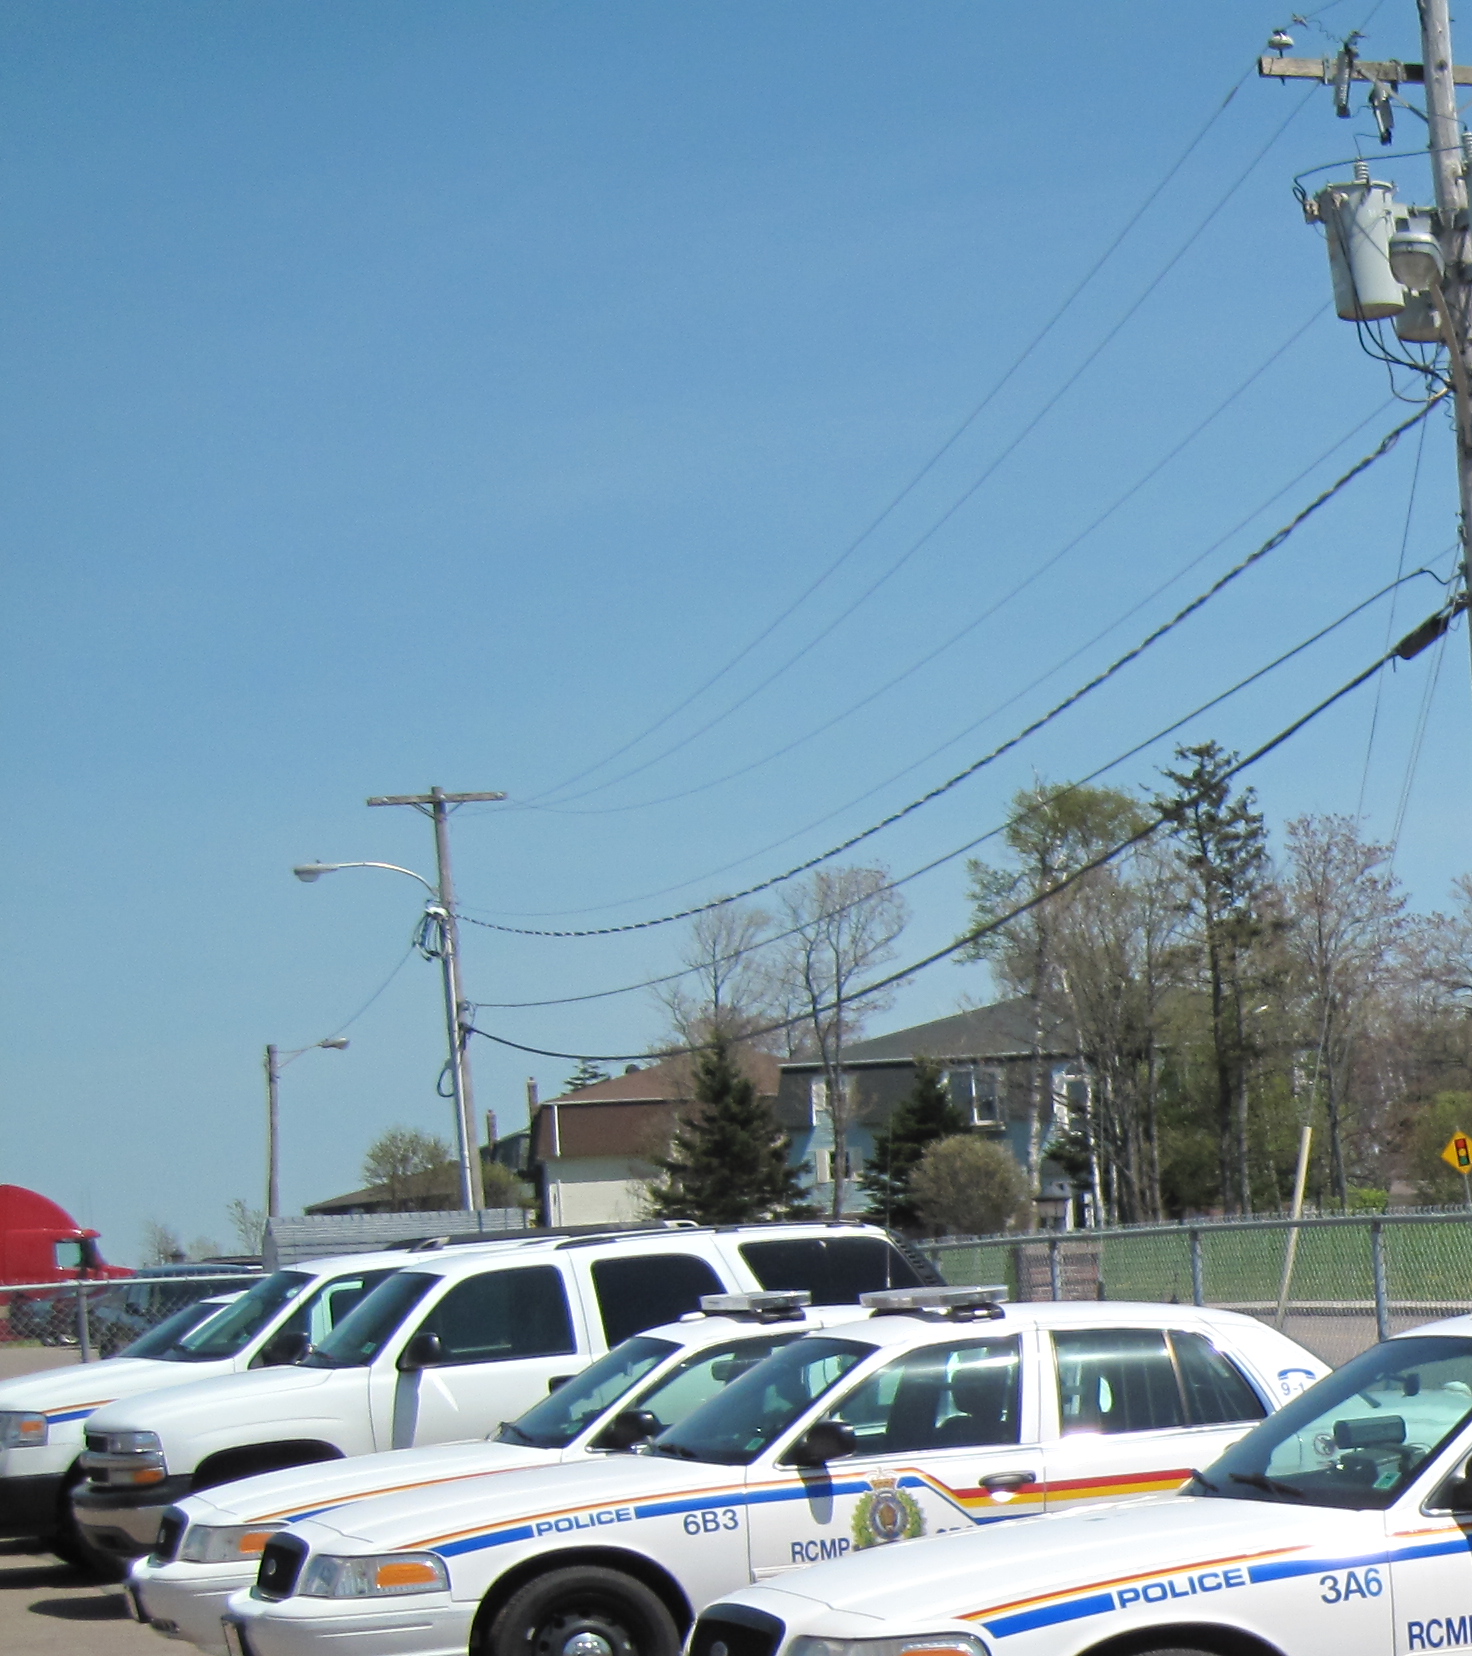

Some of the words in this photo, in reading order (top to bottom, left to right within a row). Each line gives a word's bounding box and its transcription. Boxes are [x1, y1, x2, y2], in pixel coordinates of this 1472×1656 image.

[535, 1507, 634, 1537] POLICE
[683, 1508, 739, 1536] 6B3
[791, 1537, 850, 1563] RCMP
[1116, 1568, 1246, 1609] POLICE
[1319, 1567, 1383, 1605] 3A6
